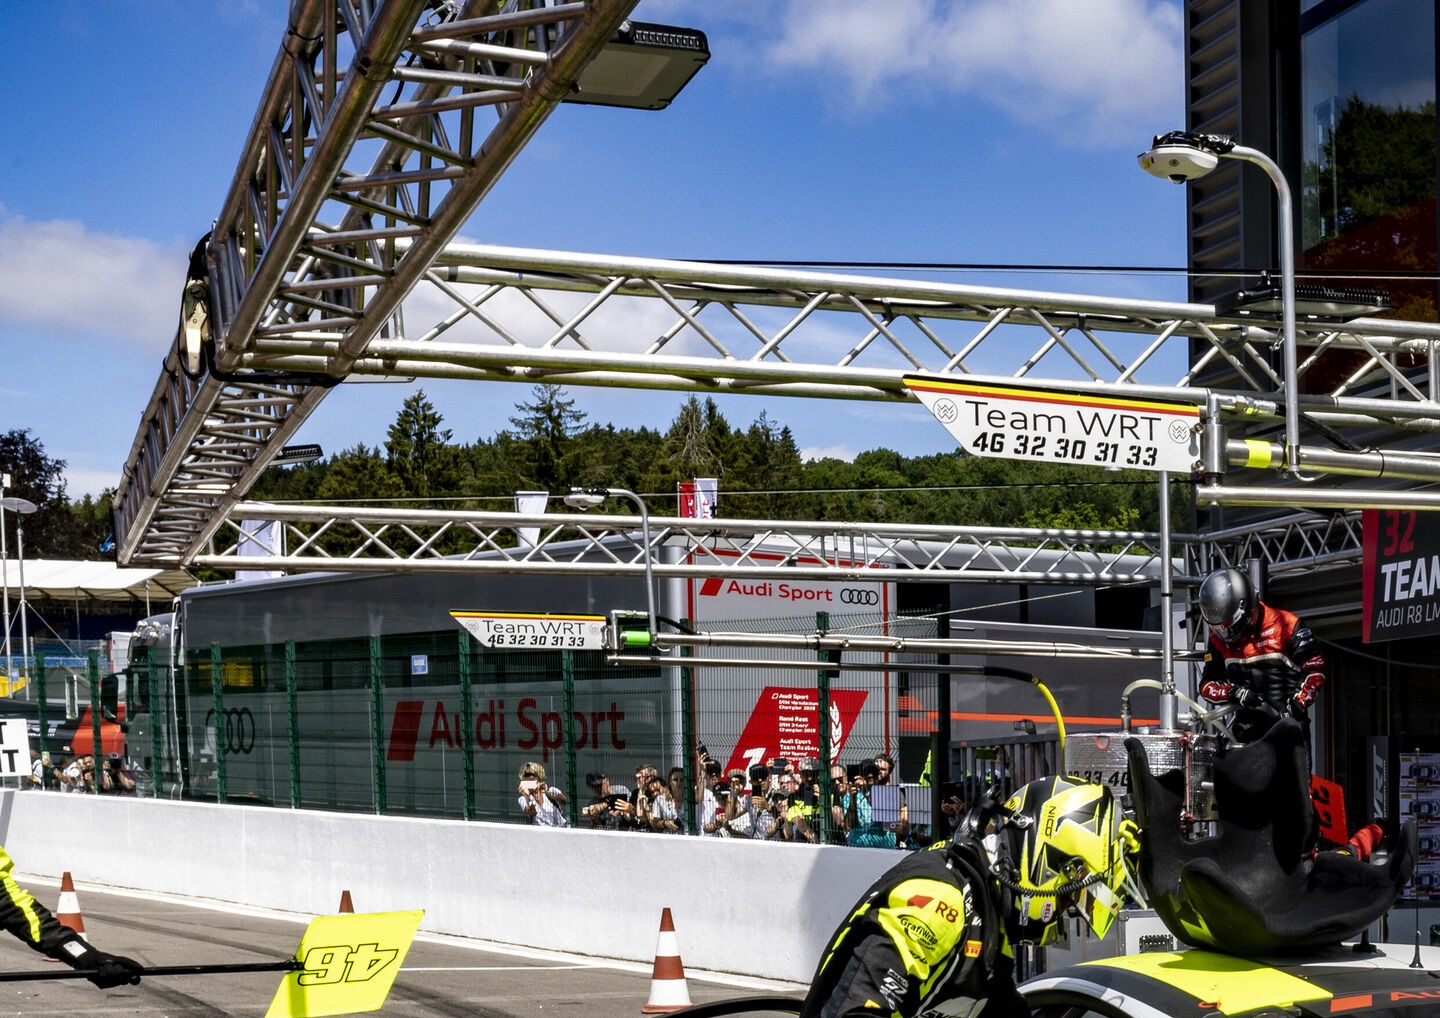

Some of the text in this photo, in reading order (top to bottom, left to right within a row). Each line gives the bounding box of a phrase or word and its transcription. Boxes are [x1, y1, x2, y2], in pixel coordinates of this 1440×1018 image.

[965, 400, 1162, 441] Team WRT
[972, 432, 1158, 467] 46 32 30 31 33
[1384, 510, 1416, 556] 32
[727, 580, 832, 601] Audi Sport
[482, 620, 586, 636] Team WRT
[1376, 607, 1404, 628] AUDI
[1406, 605, 1422, 624] R8
[488, 634, 585, 647] 46 32 30 31 33
[517, 698, 627, 763] Sport
[935, 901, 959, 923] R8
[298, 943, 399, 986] 46
